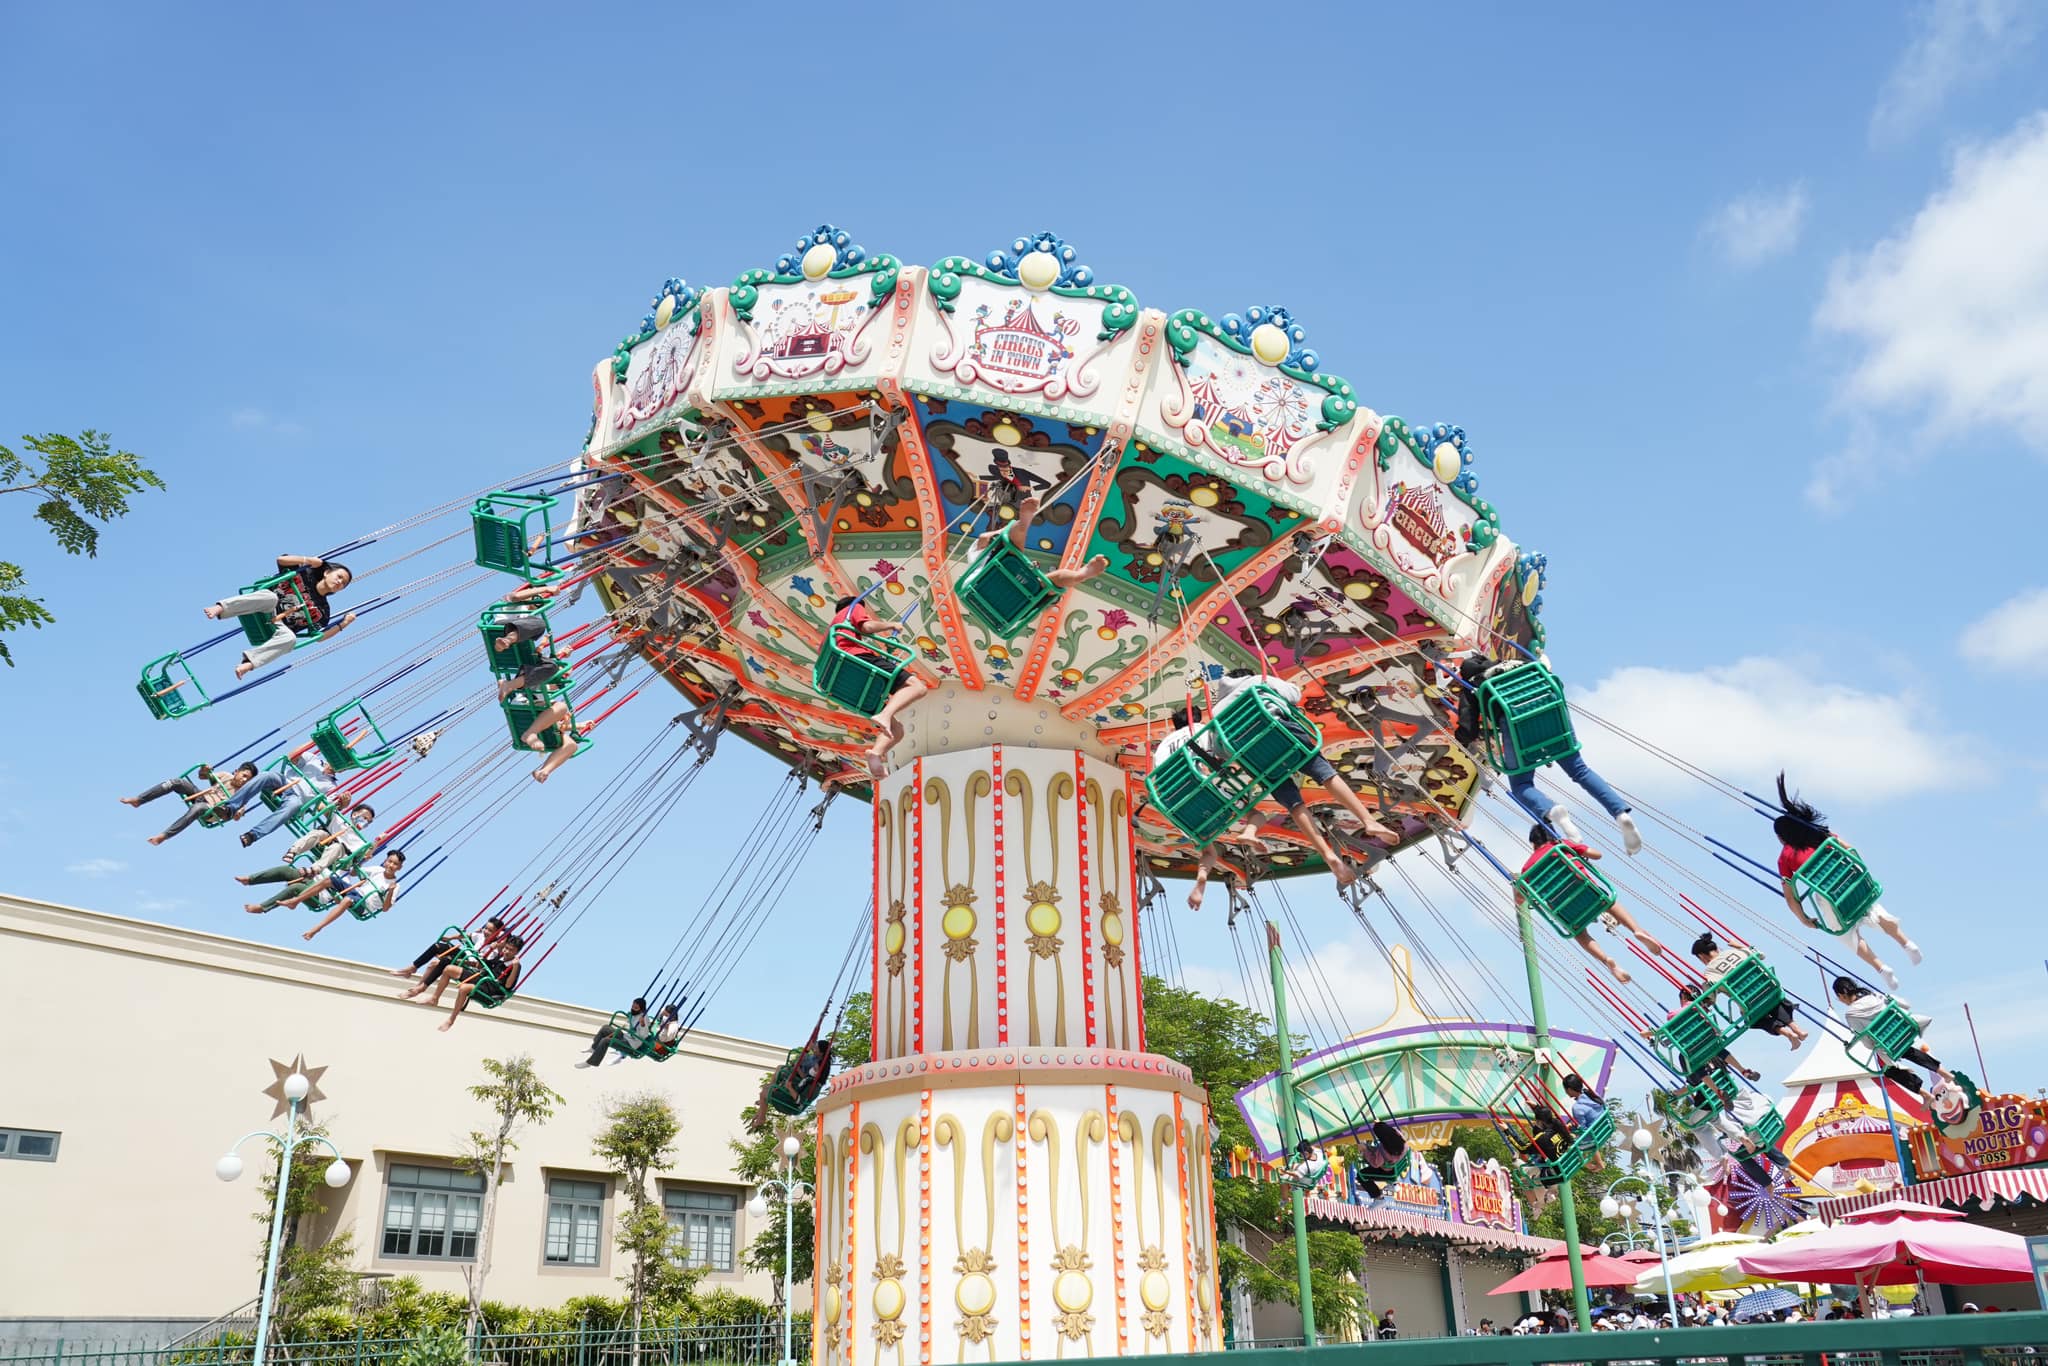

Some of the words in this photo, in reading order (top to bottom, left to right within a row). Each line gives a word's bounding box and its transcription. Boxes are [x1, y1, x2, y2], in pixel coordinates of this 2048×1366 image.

[993, 333, 1045, 357] CIRCUS
[991, 350, 1005, 363] IN
[1007, 352, 1040, 370] TOWN
[1979, 1105, 2023, 1132] BIG
[1964, 1130, 2023, 1154] MOUTH
[1979, 1151, 2008, 1164] TOSS
[1474, 1173, 1498, 1192] LUCKY
[1475, 1194, 1502, 1214] CIRCUS
